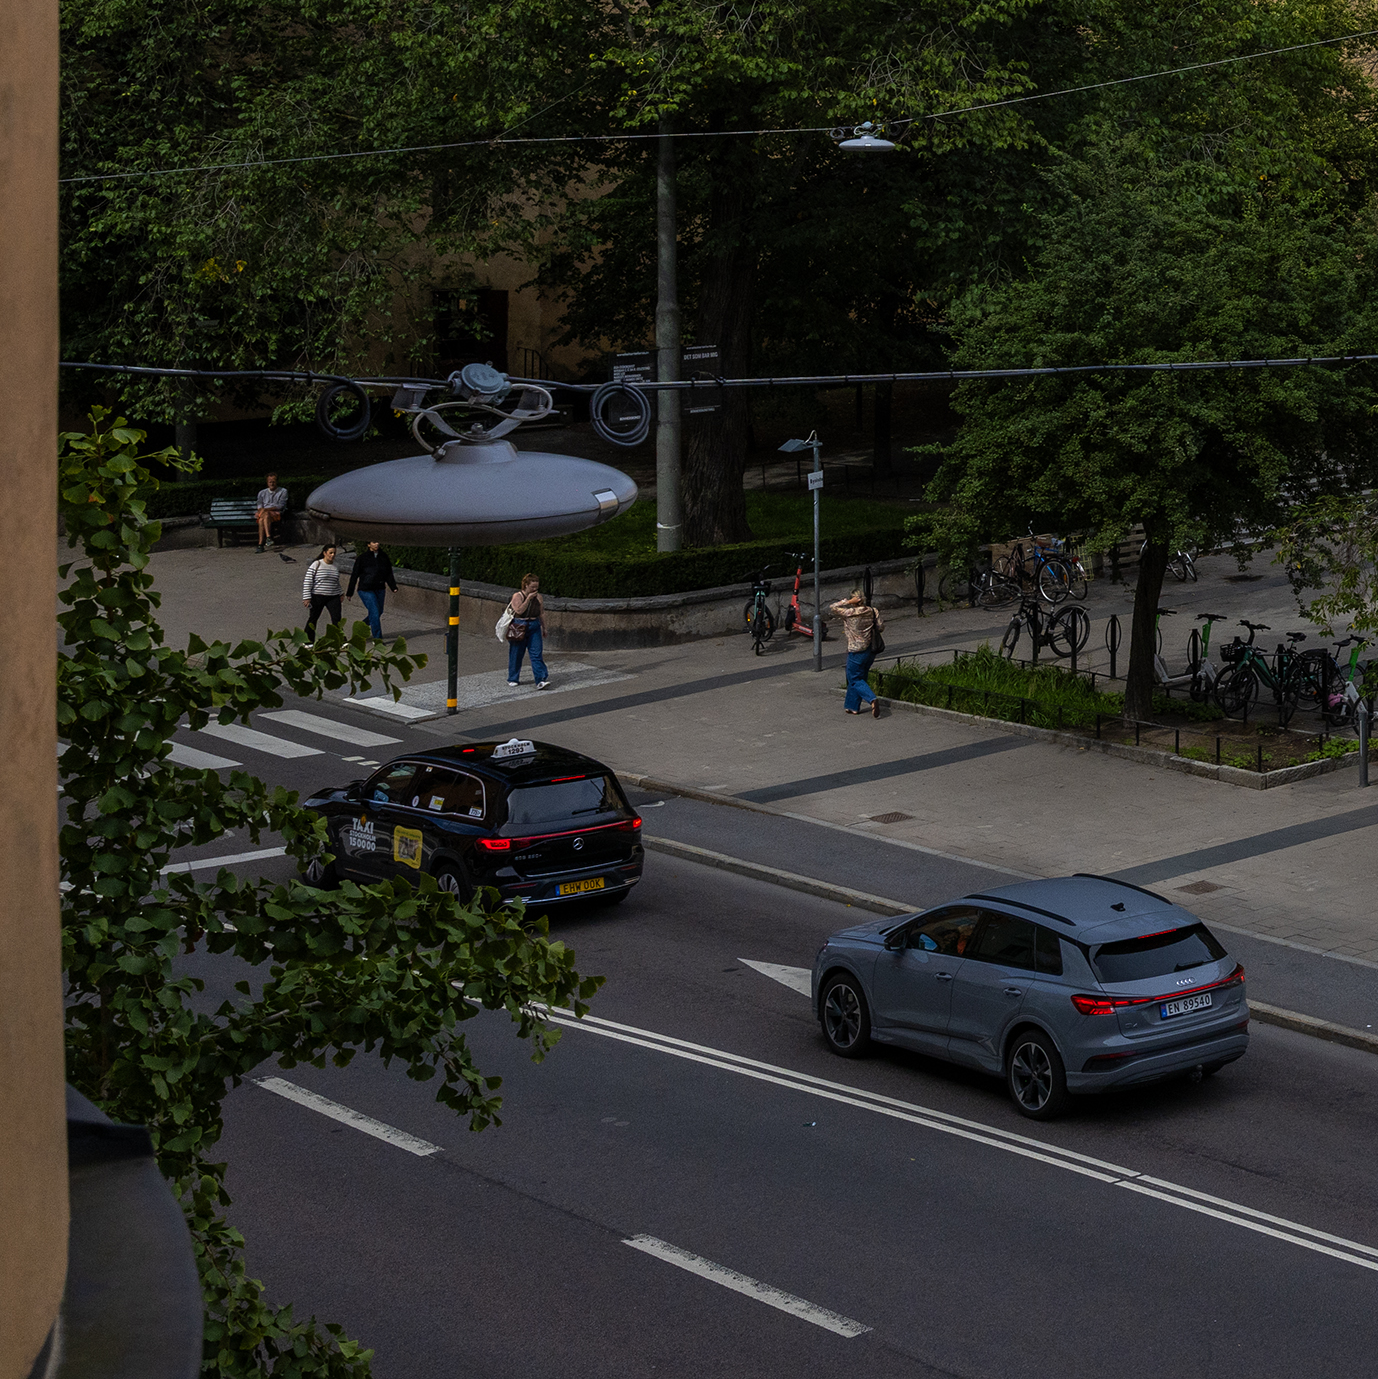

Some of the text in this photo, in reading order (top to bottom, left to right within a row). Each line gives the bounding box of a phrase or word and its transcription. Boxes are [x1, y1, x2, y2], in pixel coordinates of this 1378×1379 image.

[352, 817, 374, 835] TAXI
[349, 829, 377, 842] STOCKHOLM
[349, 836, 376, 852] 150000
[1168, 1001, 1180, 1014] EN
[1183, 994, 1211, 1011] 89540
